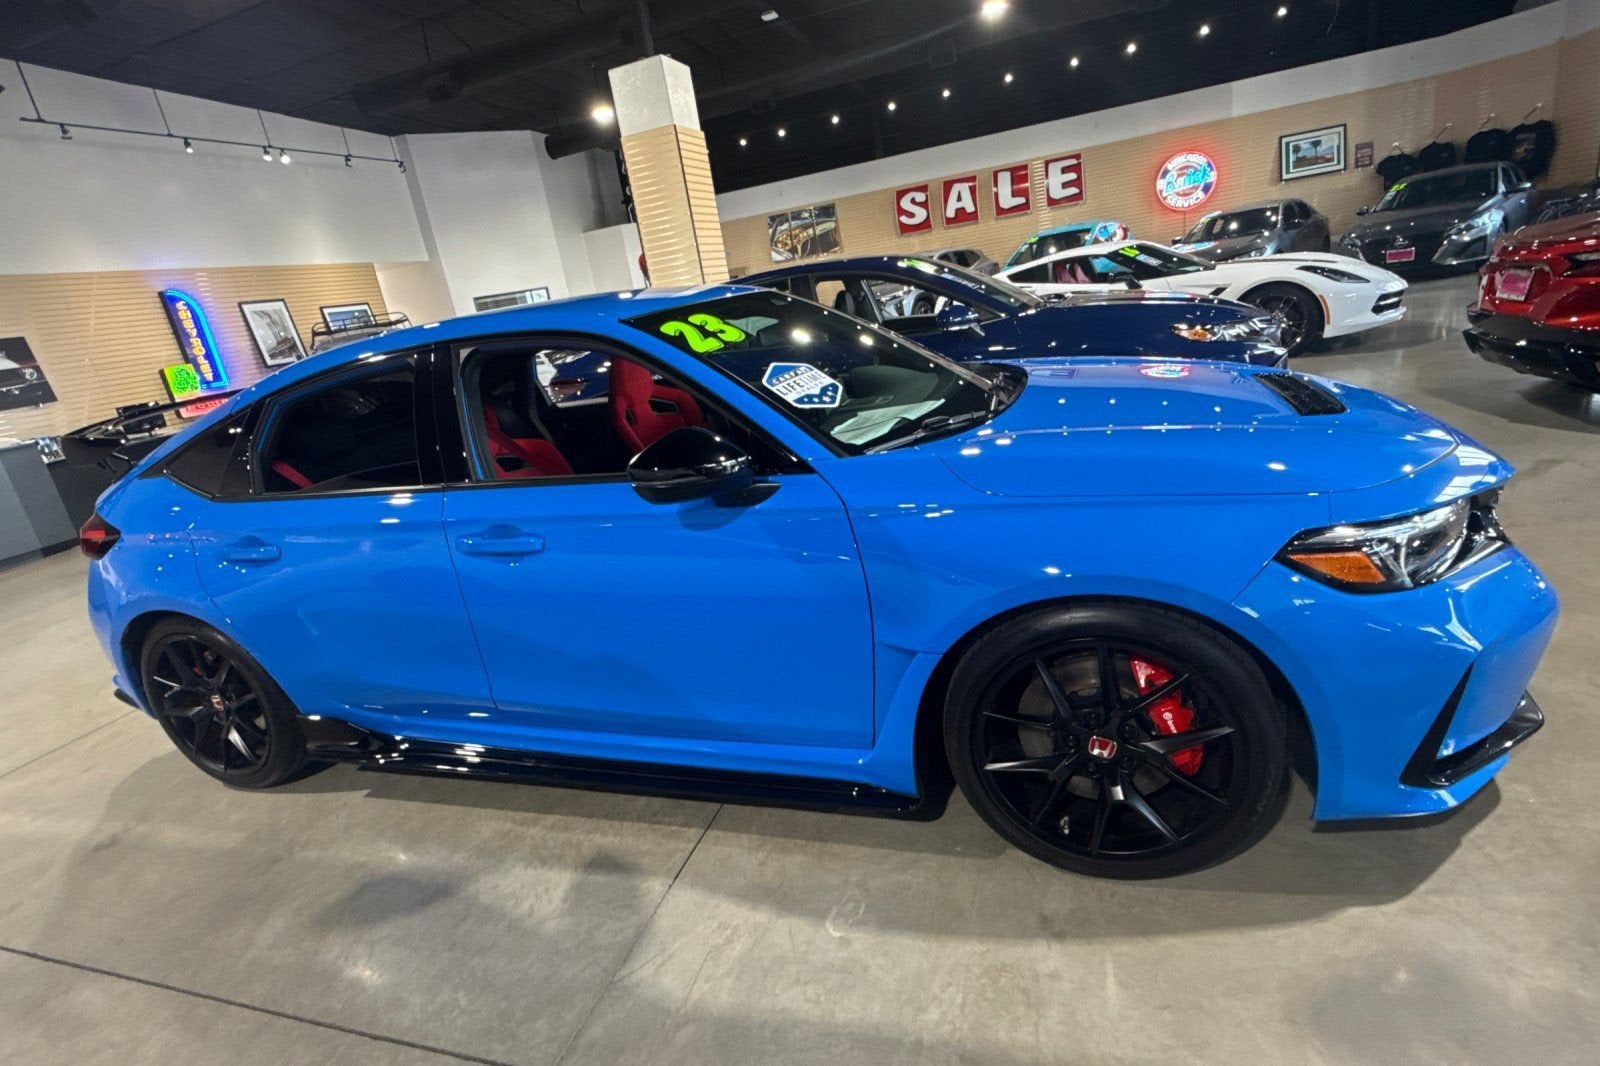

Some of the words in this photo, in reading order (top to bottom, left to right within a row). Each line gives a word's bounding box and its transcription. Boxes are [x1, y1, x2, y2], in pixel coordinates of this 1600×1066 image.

[899, 158, 1080, 226] SALE
[1165, 191, 1206, 208] SERVICE
[175, 300, 214, 382] CHEVROLET
[660, 314, 746, 353] 23
[775, 371, 827, 396] LIFETIME
